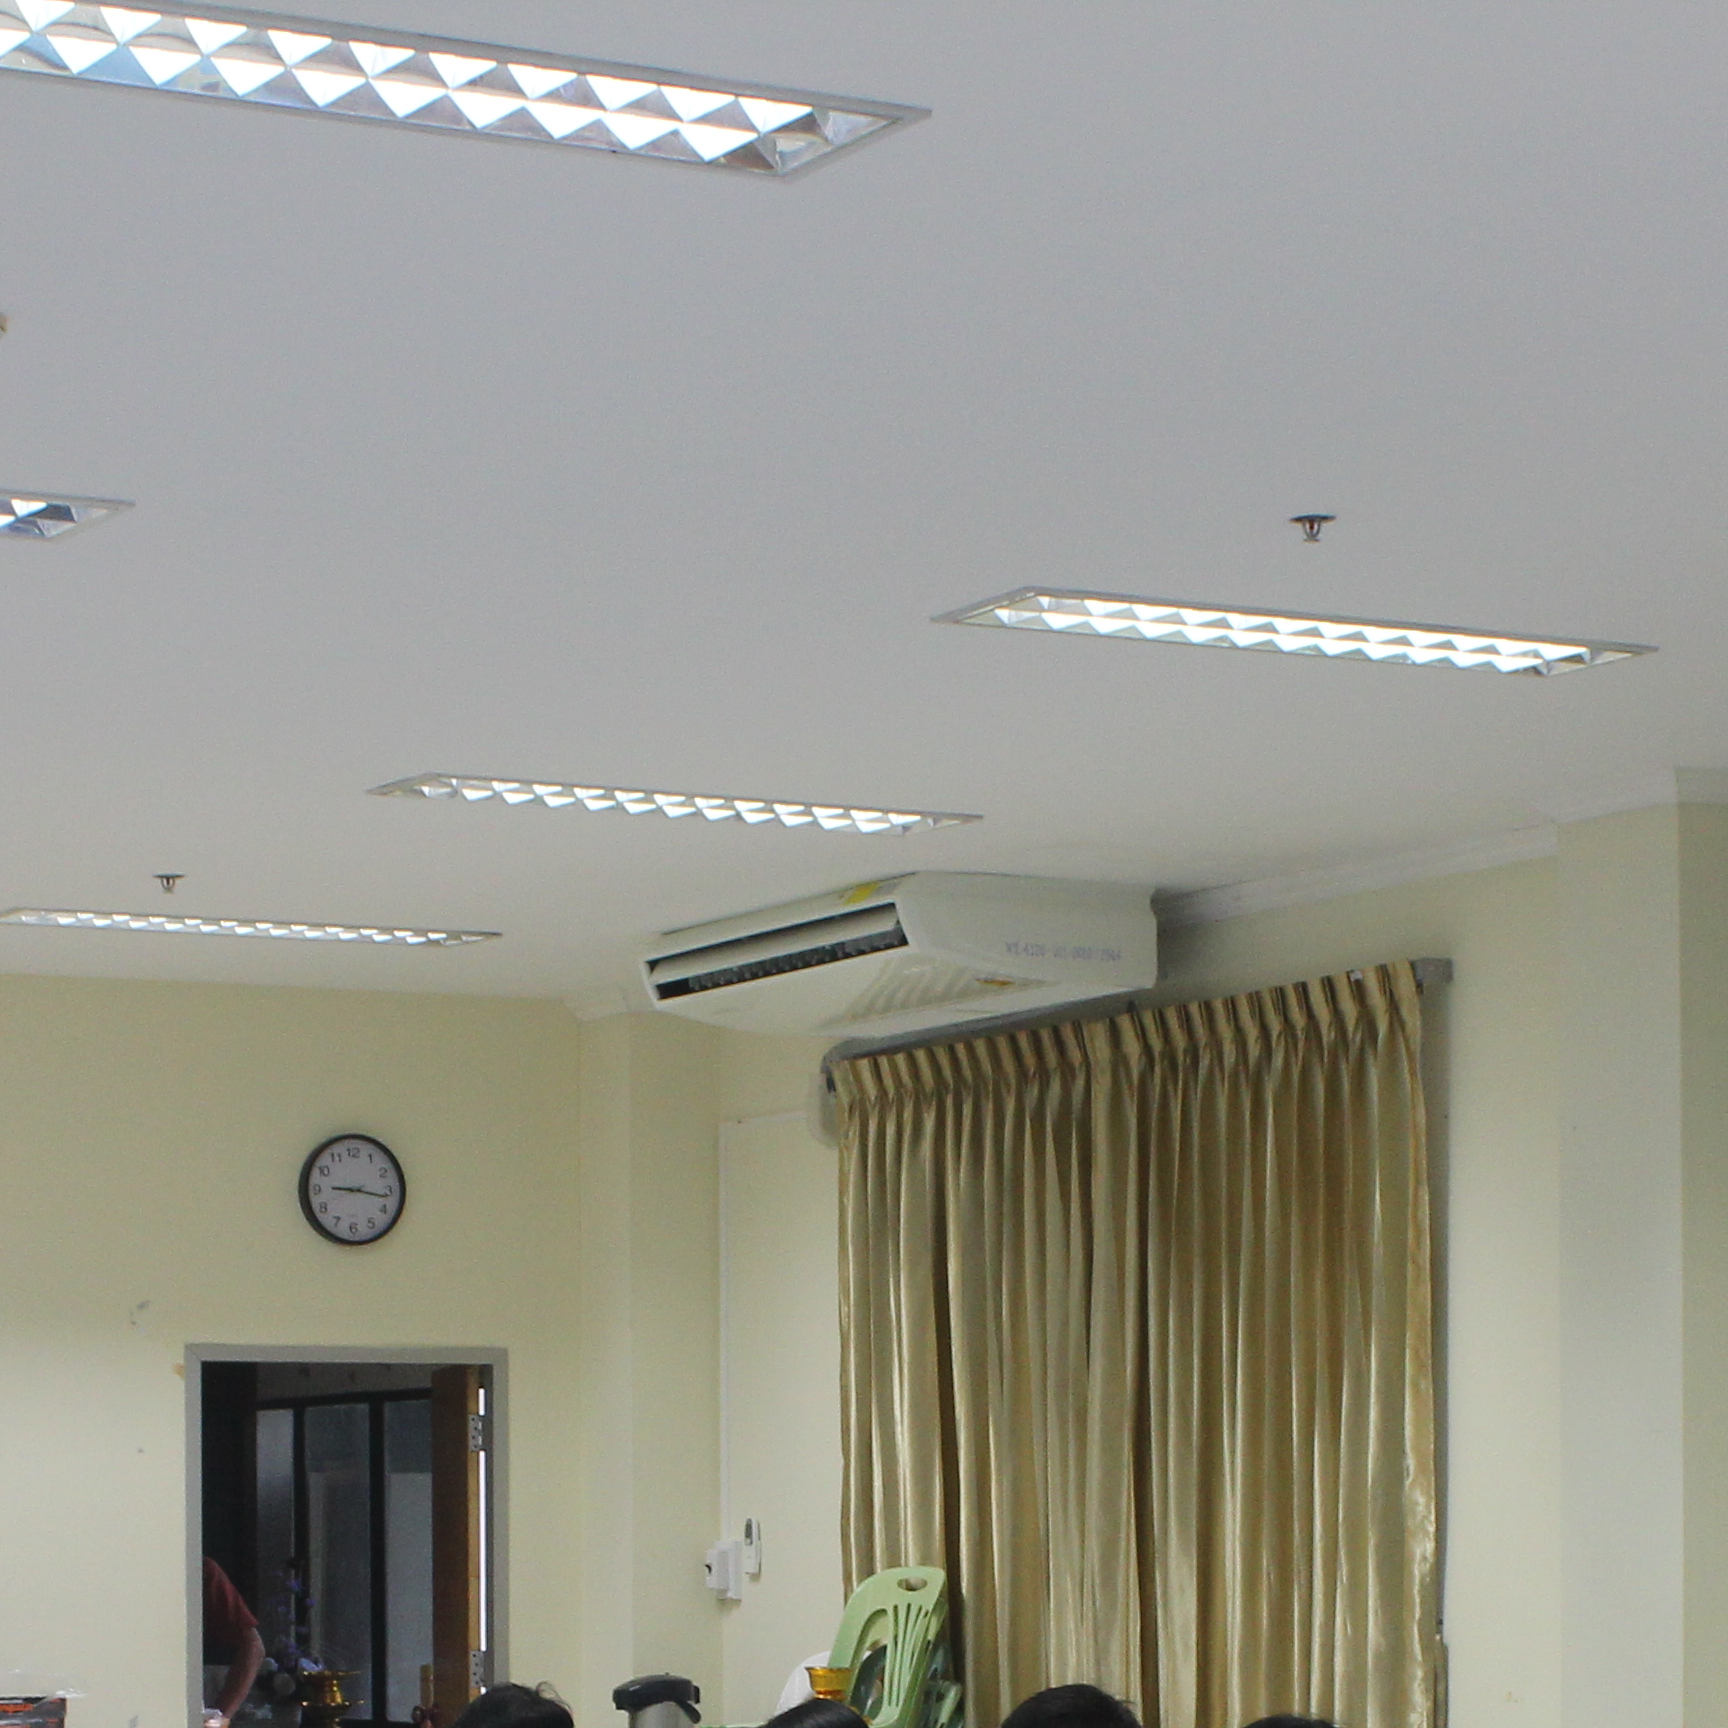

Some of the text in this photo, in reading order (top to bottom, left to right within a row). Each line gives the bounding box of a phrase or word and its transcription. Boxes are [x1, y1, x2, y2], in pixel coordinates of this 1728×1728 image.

[331, 1152, 342, 1162] 11
[346, 1147, 360, 1158] 12
[368, 1153, 373, 1163] 1
[318, 1165, 330, 1177] 10
[379, 1166, 387, 1178] 2
[313, 1184, 321, 1195] 9
[319, 1201, 328, 1214] 8
[379, 1204, 387, 1215] 4
[333, 1215, 341, 1227] 7
[367, 1217, 375, 1229] 5
[349, 1222, 358, 1235] 6
